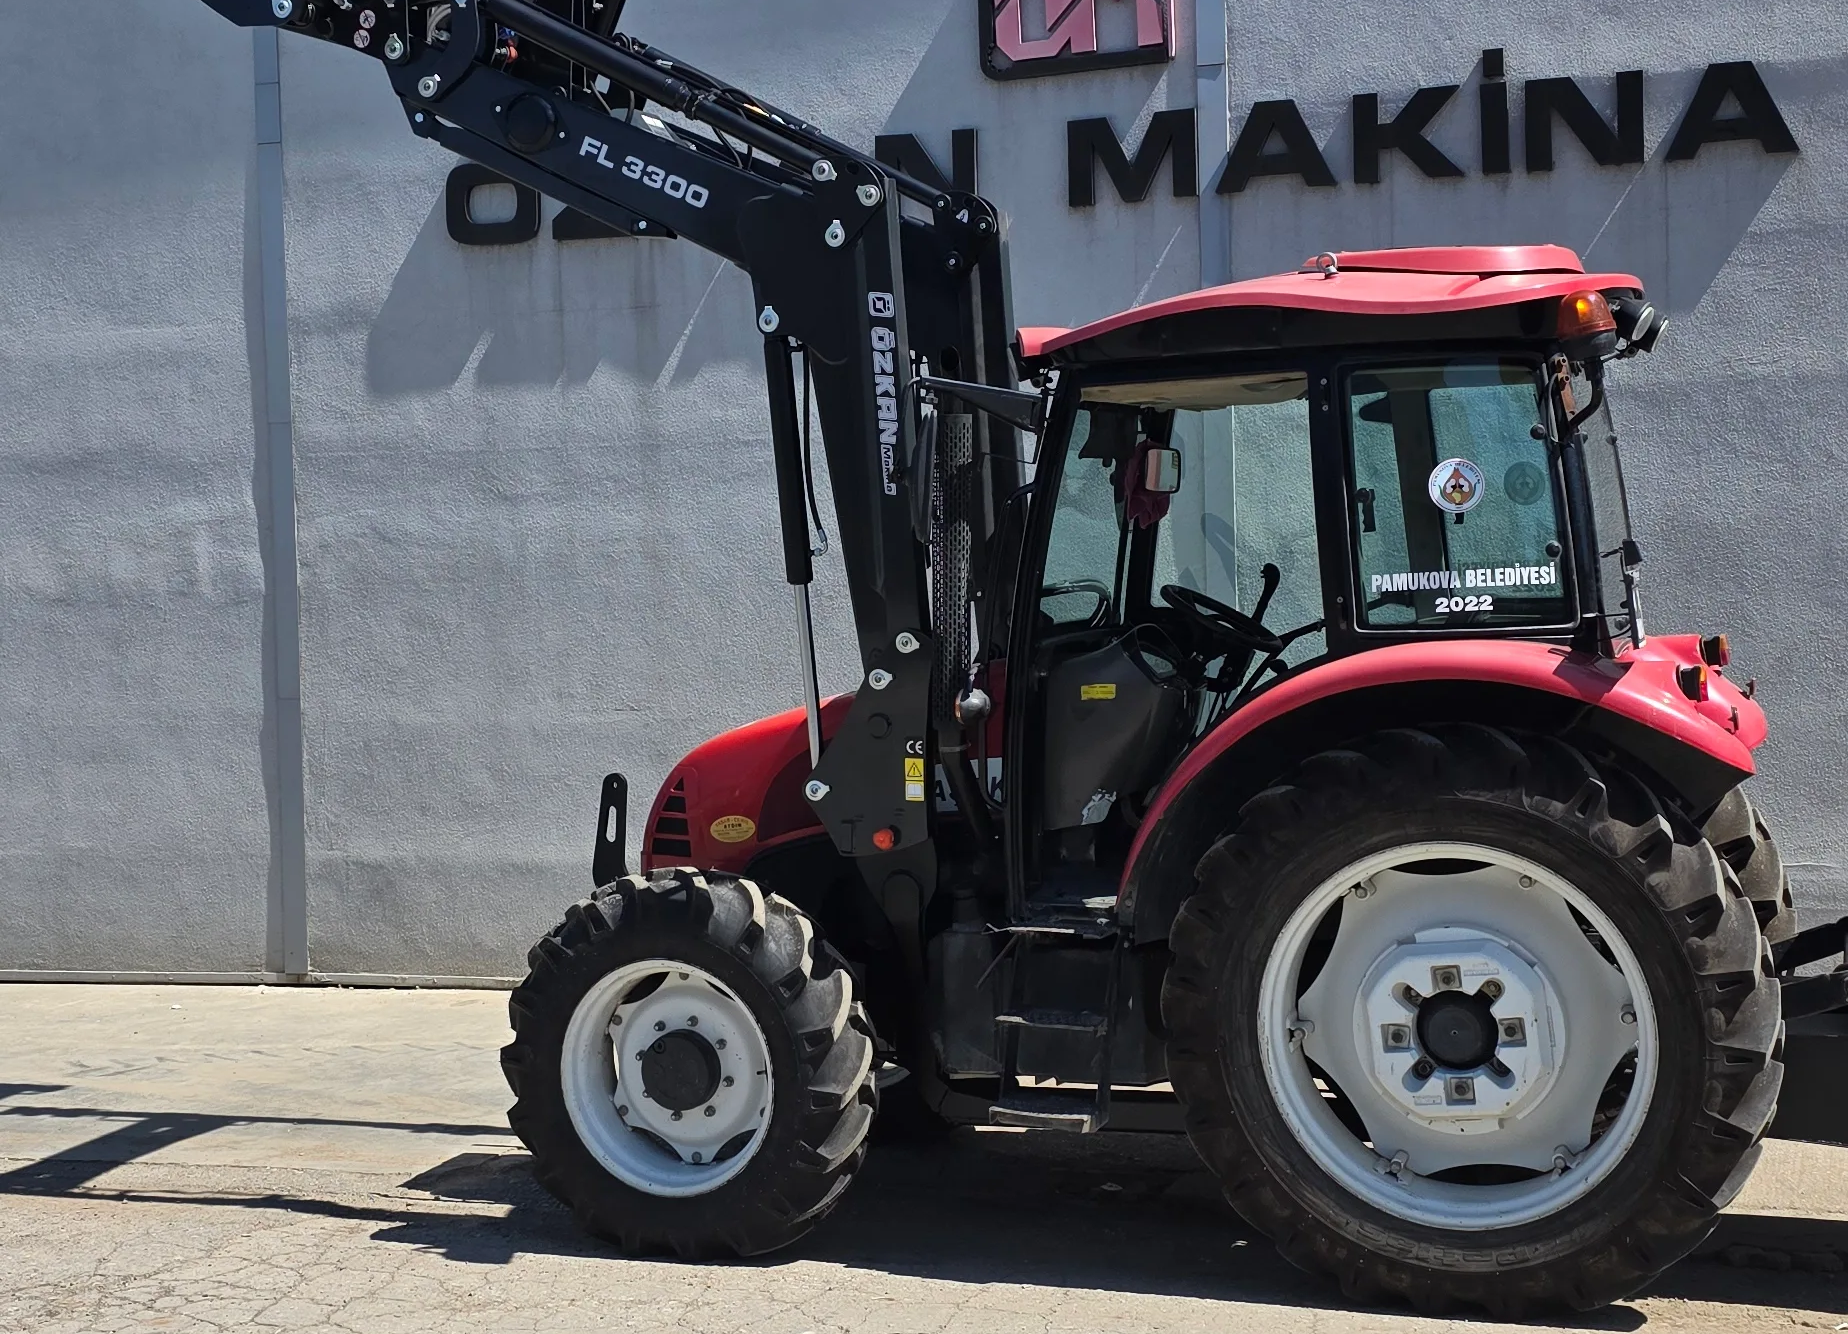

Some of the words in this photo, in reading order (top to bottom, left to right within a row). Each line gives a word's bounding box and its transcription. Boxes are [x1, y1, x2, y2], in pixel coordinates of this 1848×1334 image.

[1066, 48, 1800, 208] MAKİNA
[579, 135, 614, 169] FL
[621, 155, 710, 209] 3300
[870, 326, 898, 445] ÖZKAN
[1371, 570, 1461, 593] PAMUKOVA
[1465, 562, 1556, 588] BELEDİYESİ
[1435, 594, 1494, 613] 2022
[905, 740, 923, 755] CE
